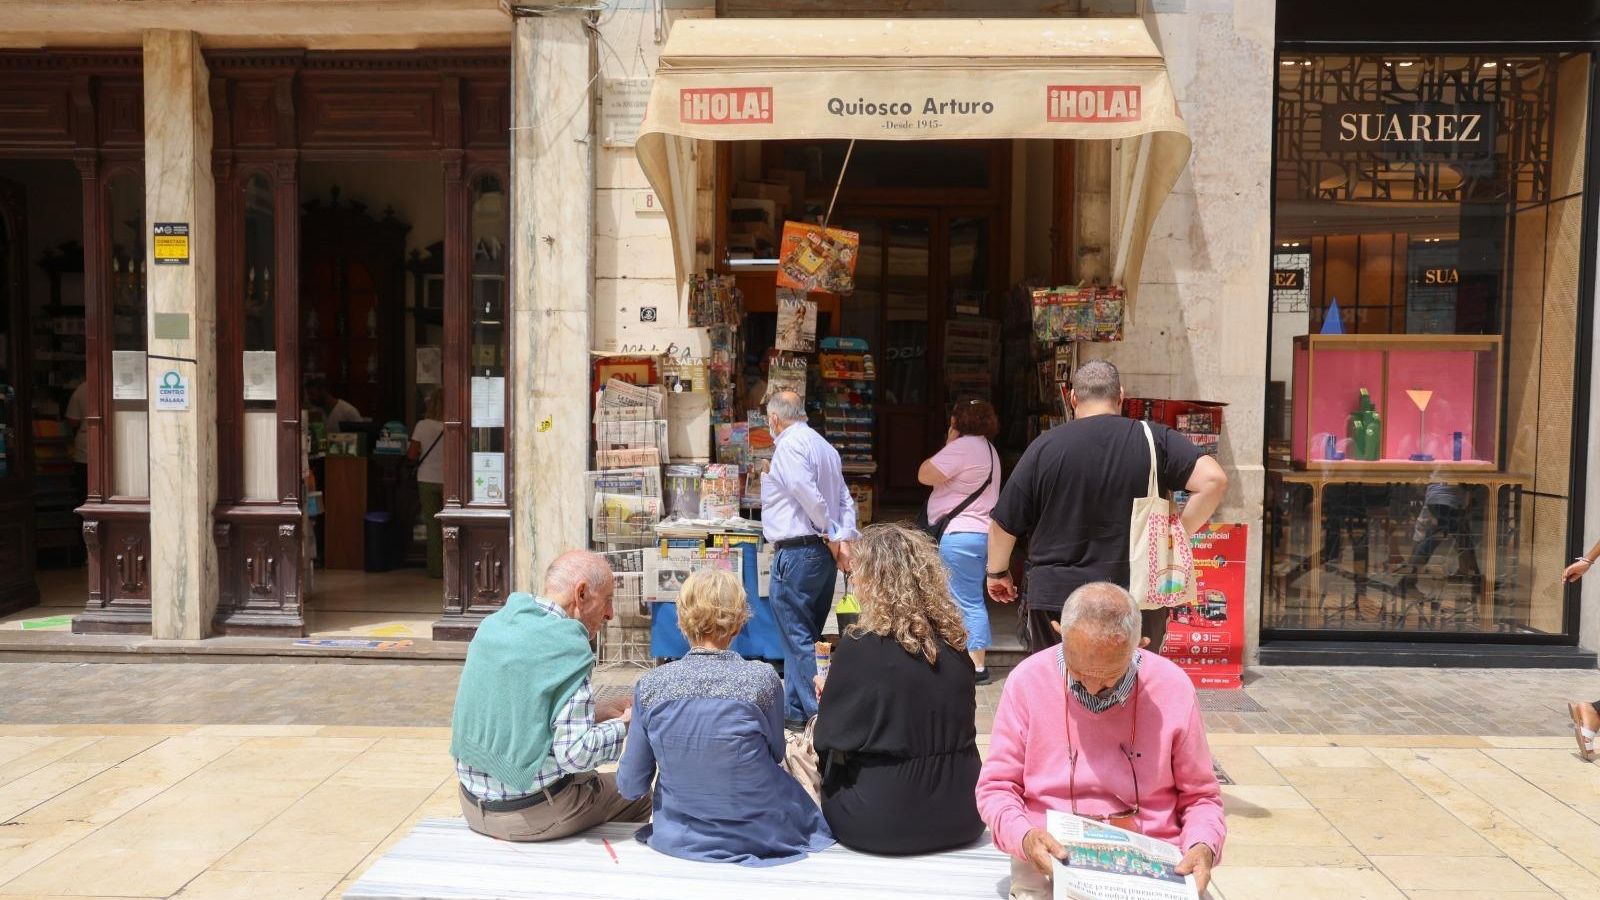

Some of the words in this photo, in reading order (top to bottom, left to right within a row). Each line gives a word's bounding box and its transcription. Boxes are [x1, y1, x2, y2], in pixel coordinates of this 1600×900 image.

[682, 91, 770, 121] ¡HOLA!
[827, 97, 913, 117] Quiosco
[922, 97, 994, 115] Arturo
[1050, 89, 1137, 119] ¡HOLA!
[1339, 112, 1482, 142] SUAREZ
[646, 194, 653, 208] 8
[1275, 272, 1297, 287] EZ
[1207, 532, 1230, 540] oficial
